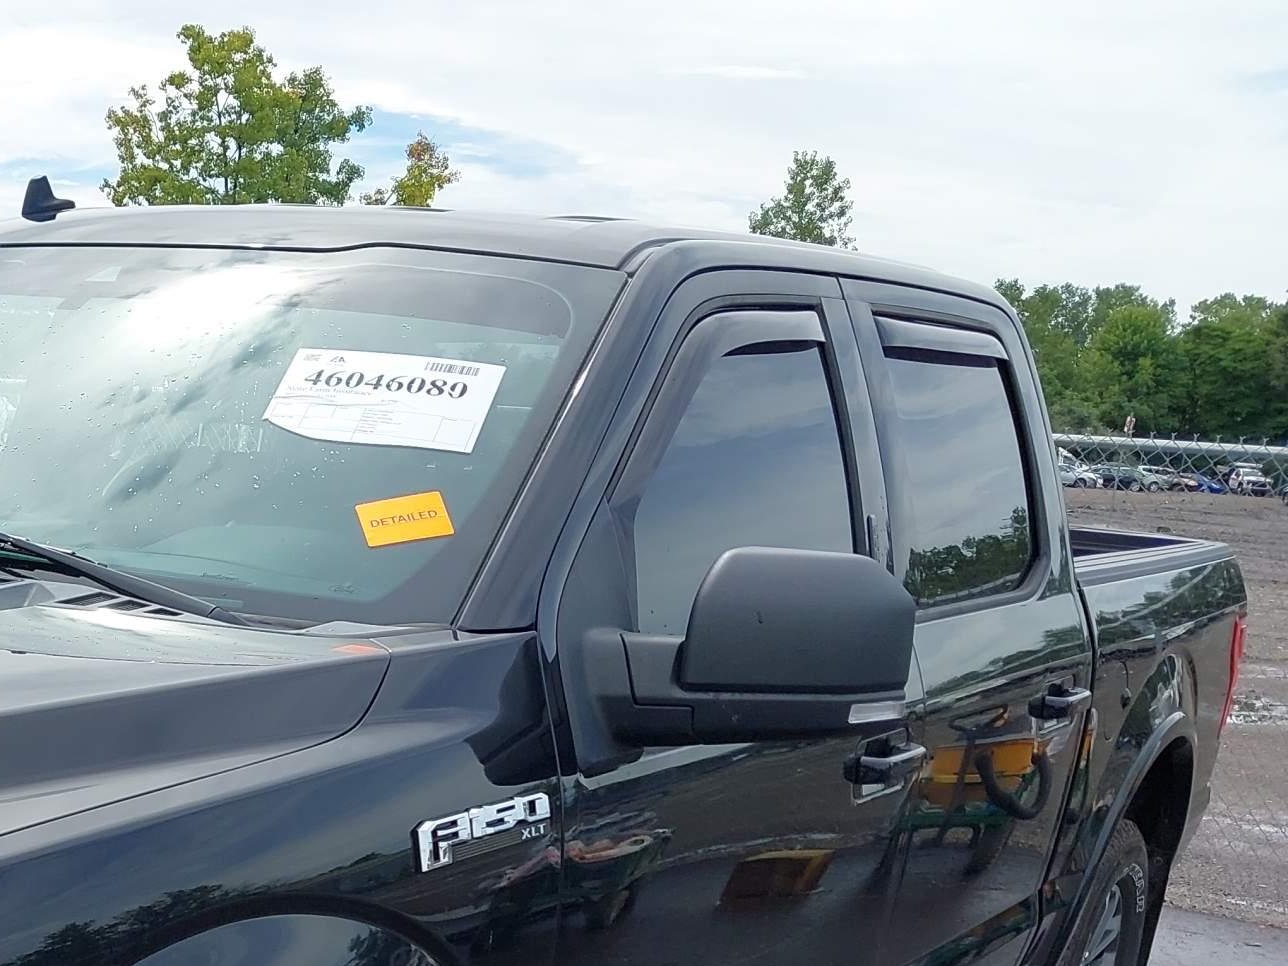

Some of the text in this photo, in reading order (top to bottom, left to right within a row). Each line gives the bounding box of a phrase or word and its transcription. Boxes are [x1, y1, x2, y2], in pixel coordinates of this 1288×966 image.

[303, 368, 469, 400] 46046089
[369, 509, 438, 529] DETAILED
[521, 822, 547, 840] XLT
